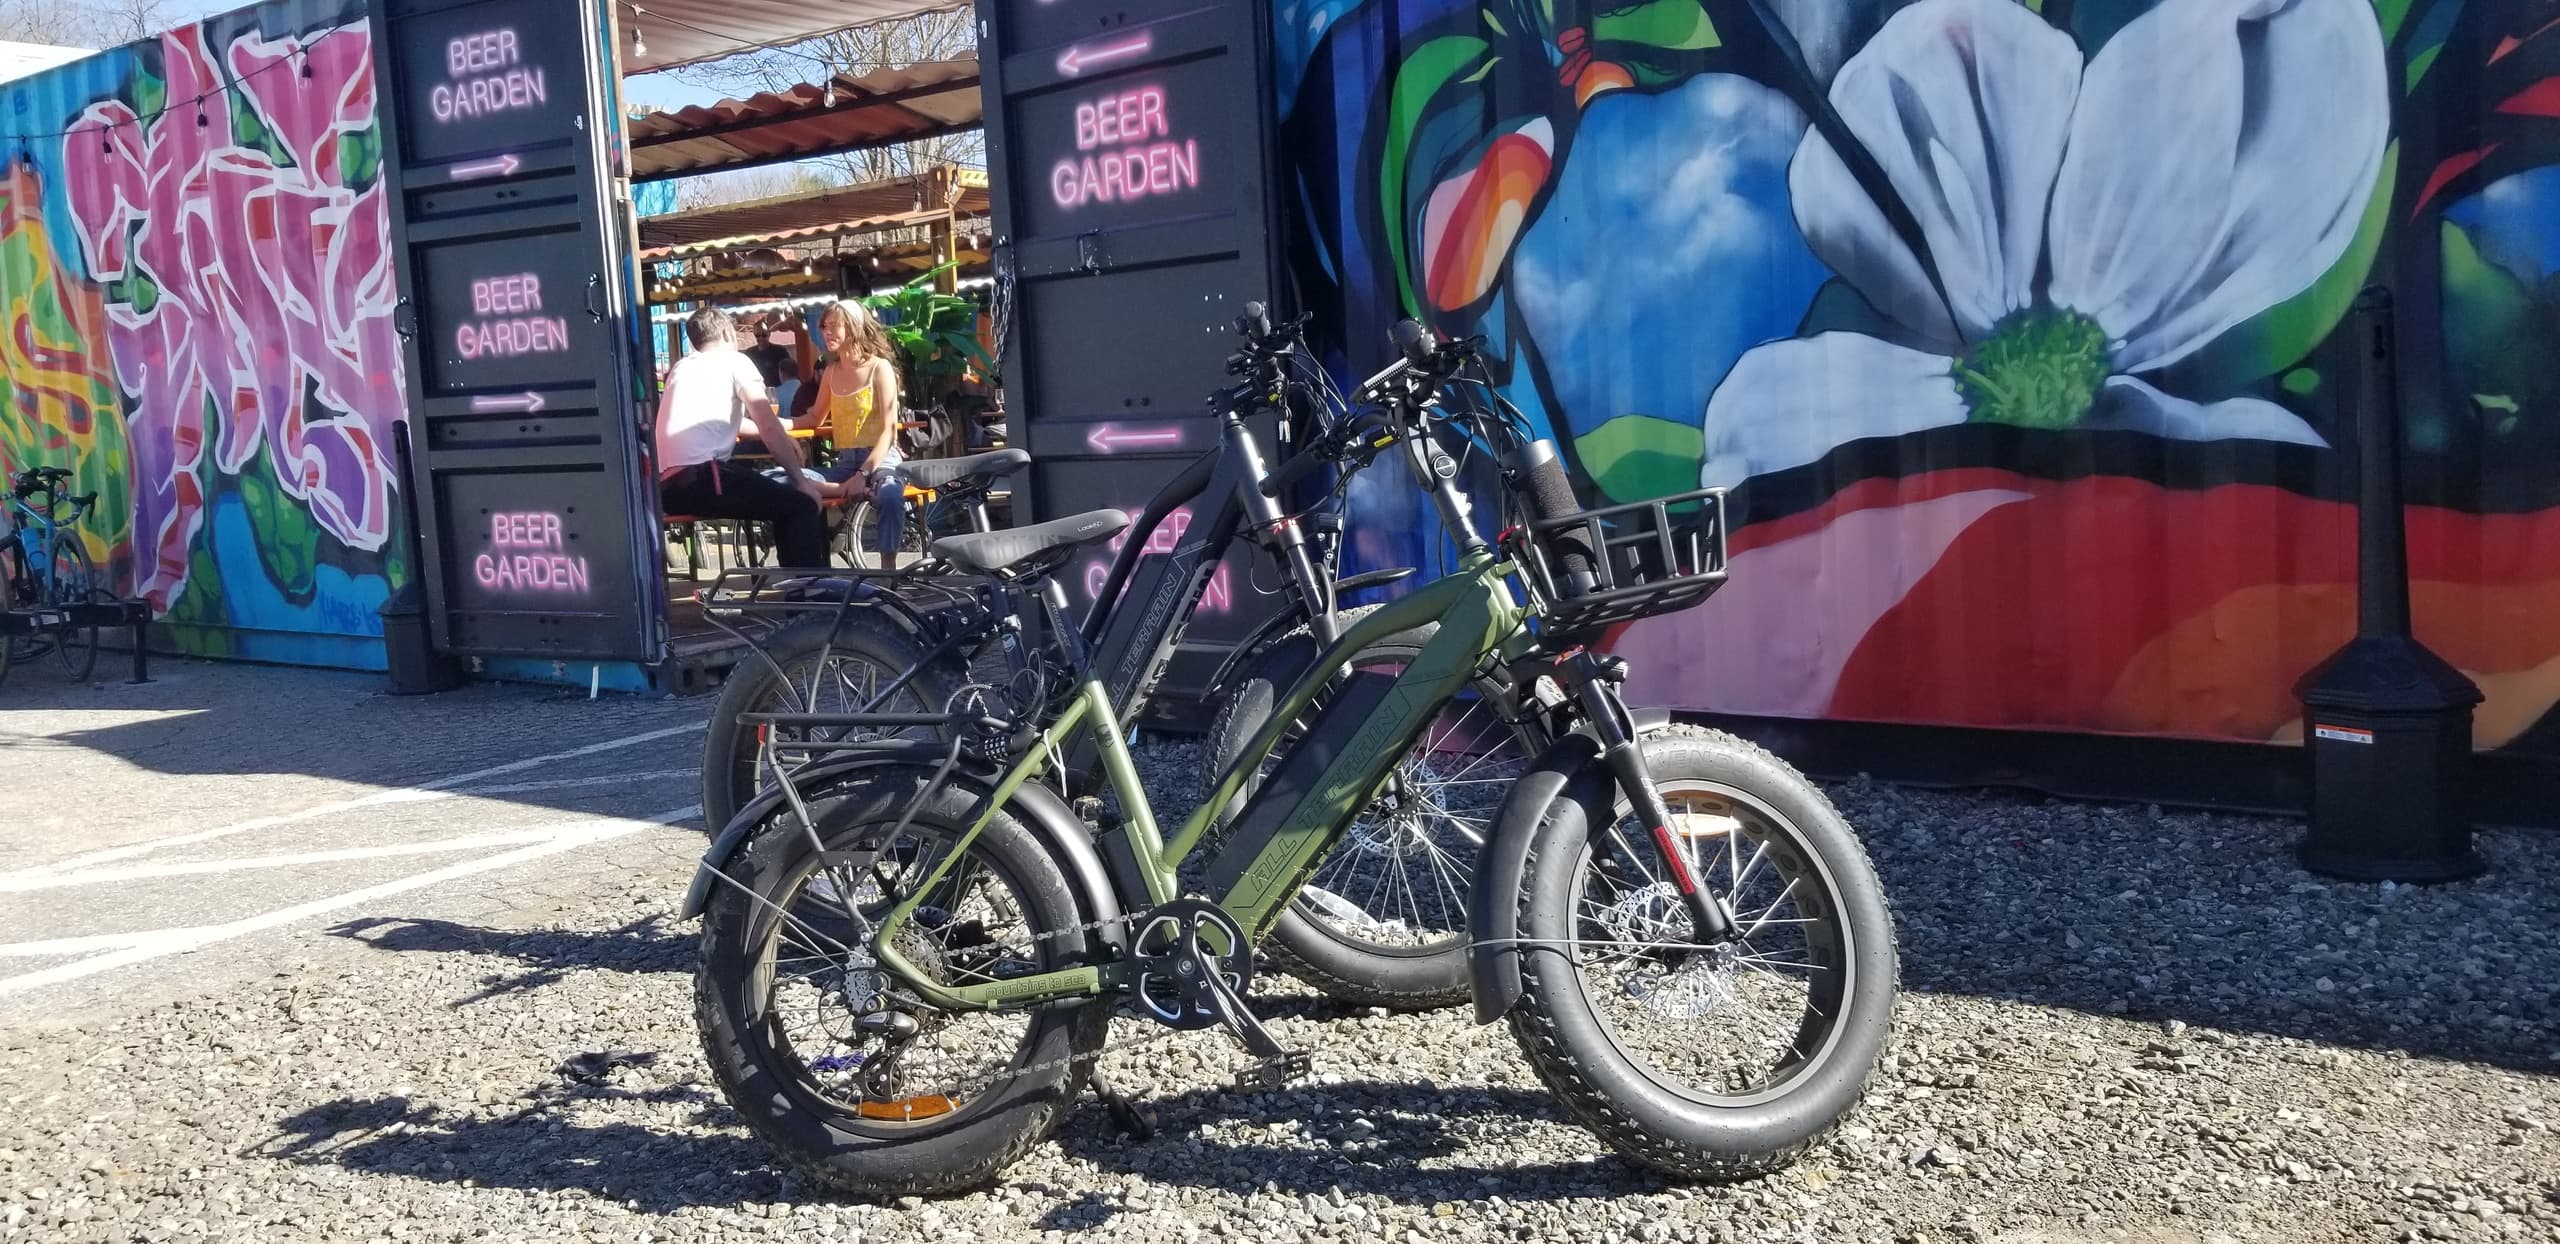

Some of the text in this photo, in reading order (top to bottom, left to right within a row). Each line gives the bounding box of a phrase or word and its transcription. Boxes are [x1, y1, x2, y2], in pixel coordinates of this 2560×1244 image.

[448, 28, 519, 74] BEER
[431, 69, 547, 119] GARDEN
[1076, 88, 1167, 149] BEER
[1052, 141, 1197, 206] GARDEN
[472, 273, 542, 314] BEER
[456, 317, 569, 357] GARDEN
[492, 512, 562, 546] BEER
[475, 553, 588, 590] GARDEN
[1120, 572, 1180, 675] TERRAIN
[1250, 704, 1400, 893] ALL TERRAIN
[985, 974, 1086, 999] mountains to sea
